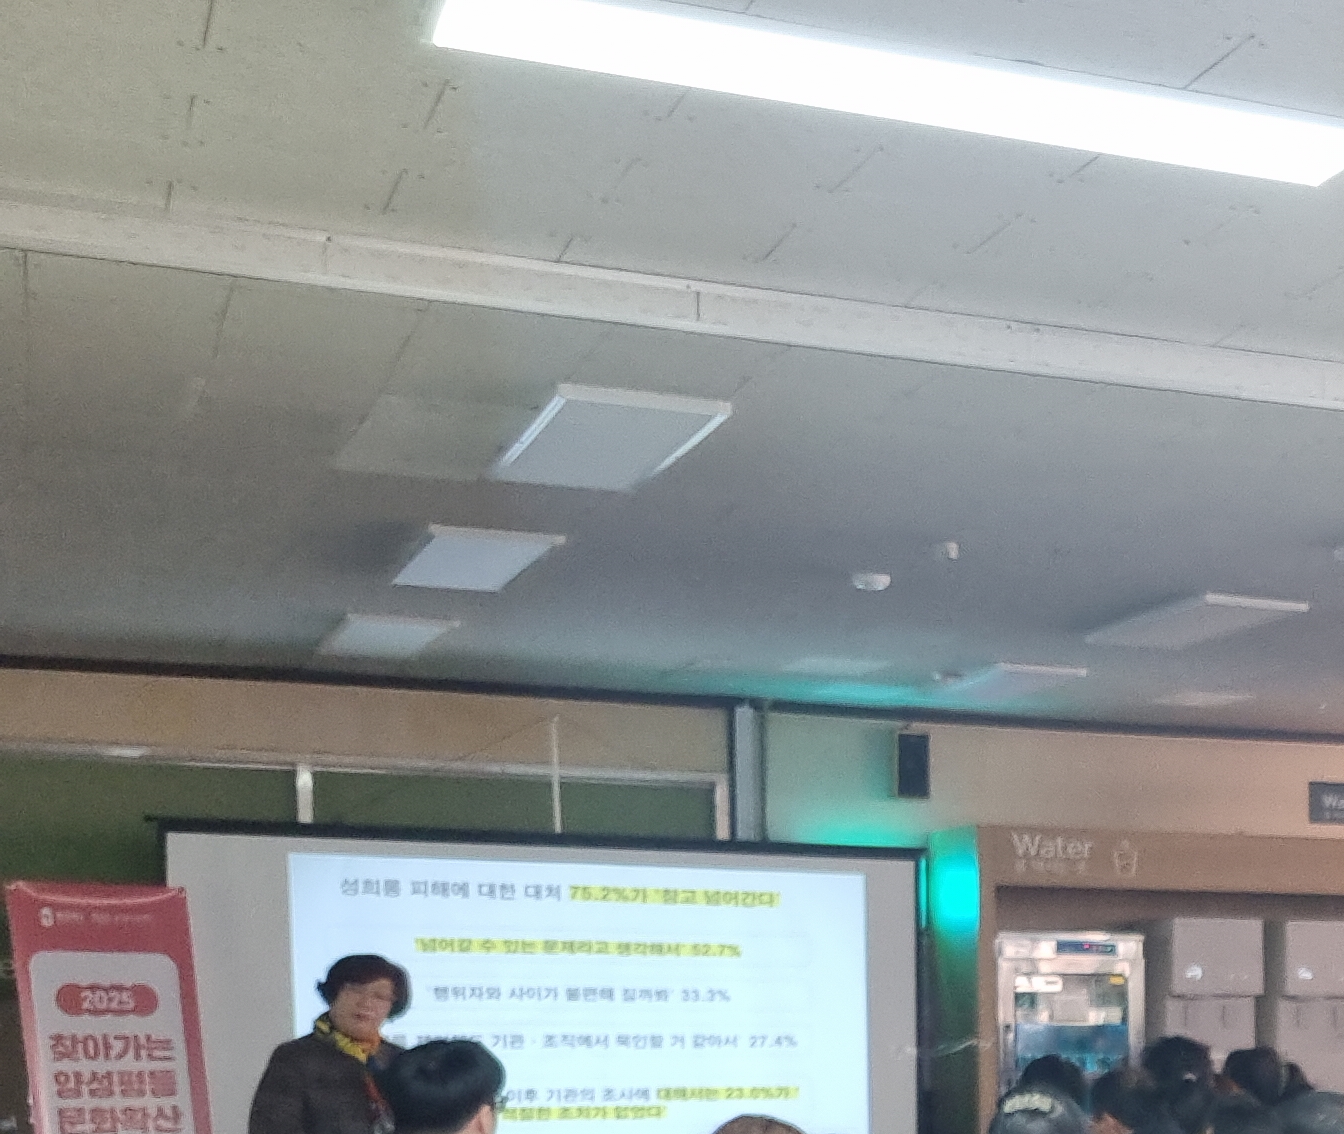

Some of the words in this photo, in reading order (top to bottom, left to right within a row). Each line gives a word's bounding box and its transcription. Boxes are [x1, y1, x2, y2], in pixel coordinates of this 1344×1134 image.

[1011, 830, 1094, 858] Water
[341, 878, 401, 897] 성희롱
[410, 880, 471, 898] 피해에
[477, 881, 516, 900] 대한
[79, 988, 136, 1012] 2025
[50, 1033, 176, 1063] 찾아가는
[54, 1069, 178, 1099] 양성평등
